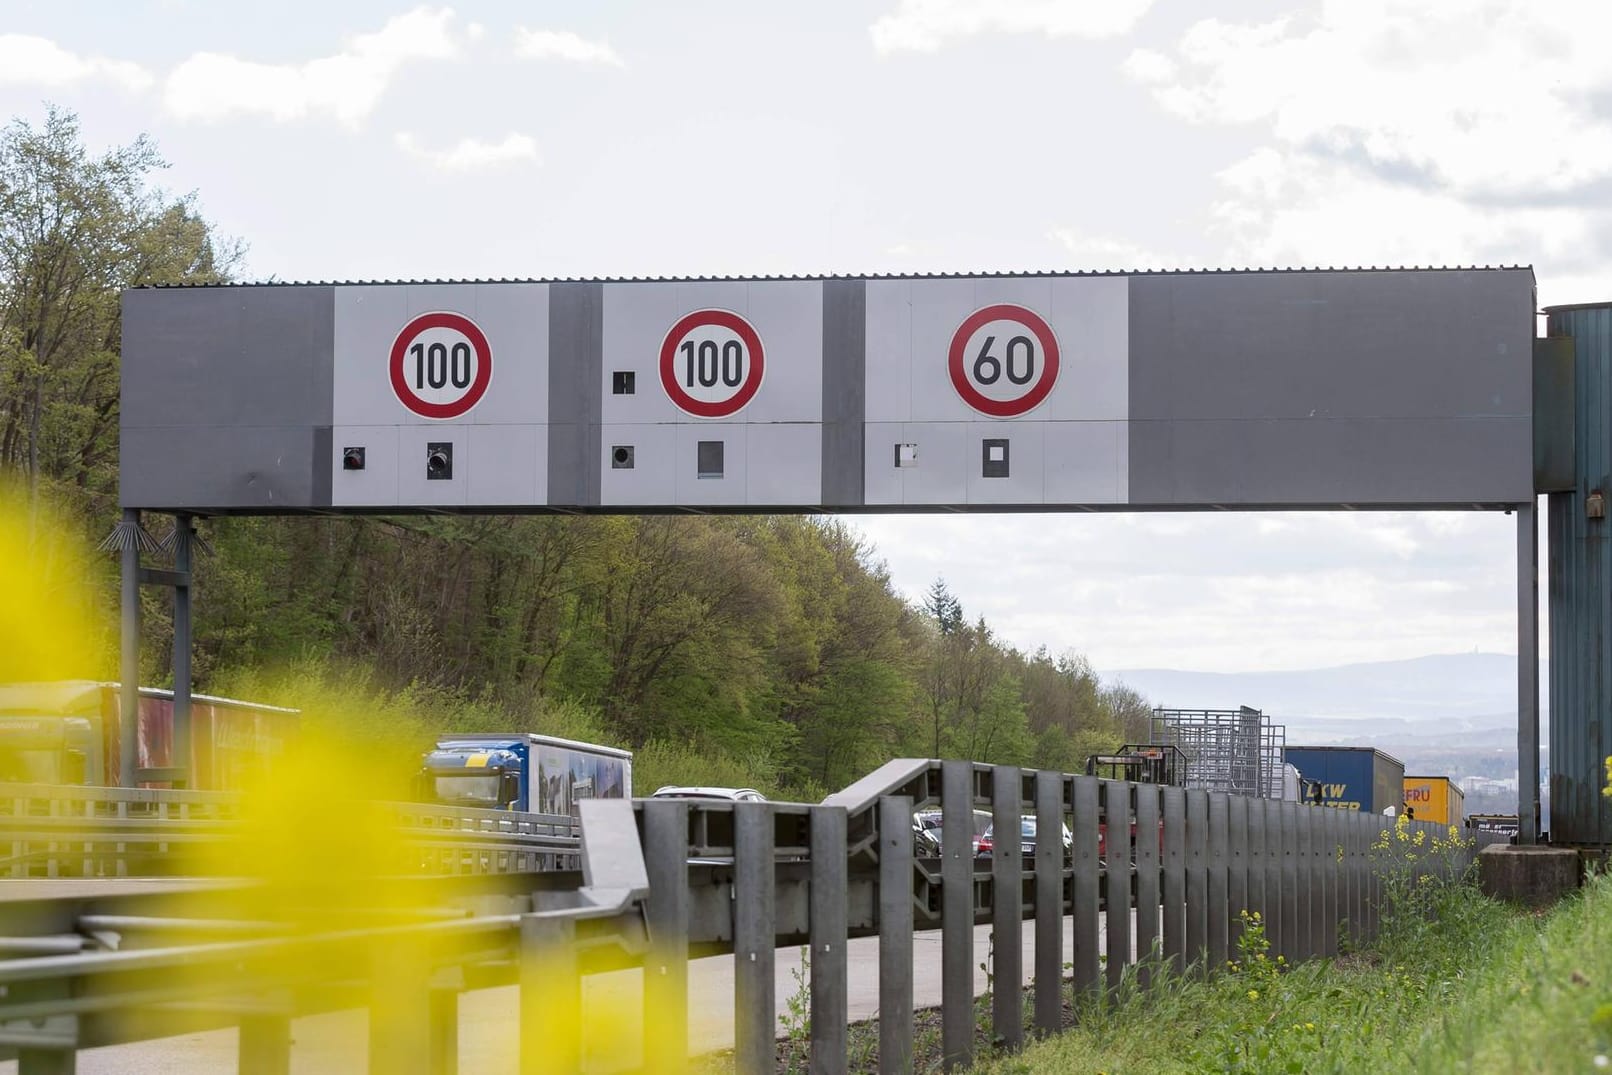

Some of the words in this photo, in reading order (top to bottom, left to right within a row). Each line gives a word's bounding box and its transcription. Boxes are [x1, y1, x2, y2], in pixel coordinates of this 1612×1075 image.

[410, 342, 471, 389] 100
[681, 340, 742, 387] 100
[973, 335, 1034, 385] 60
